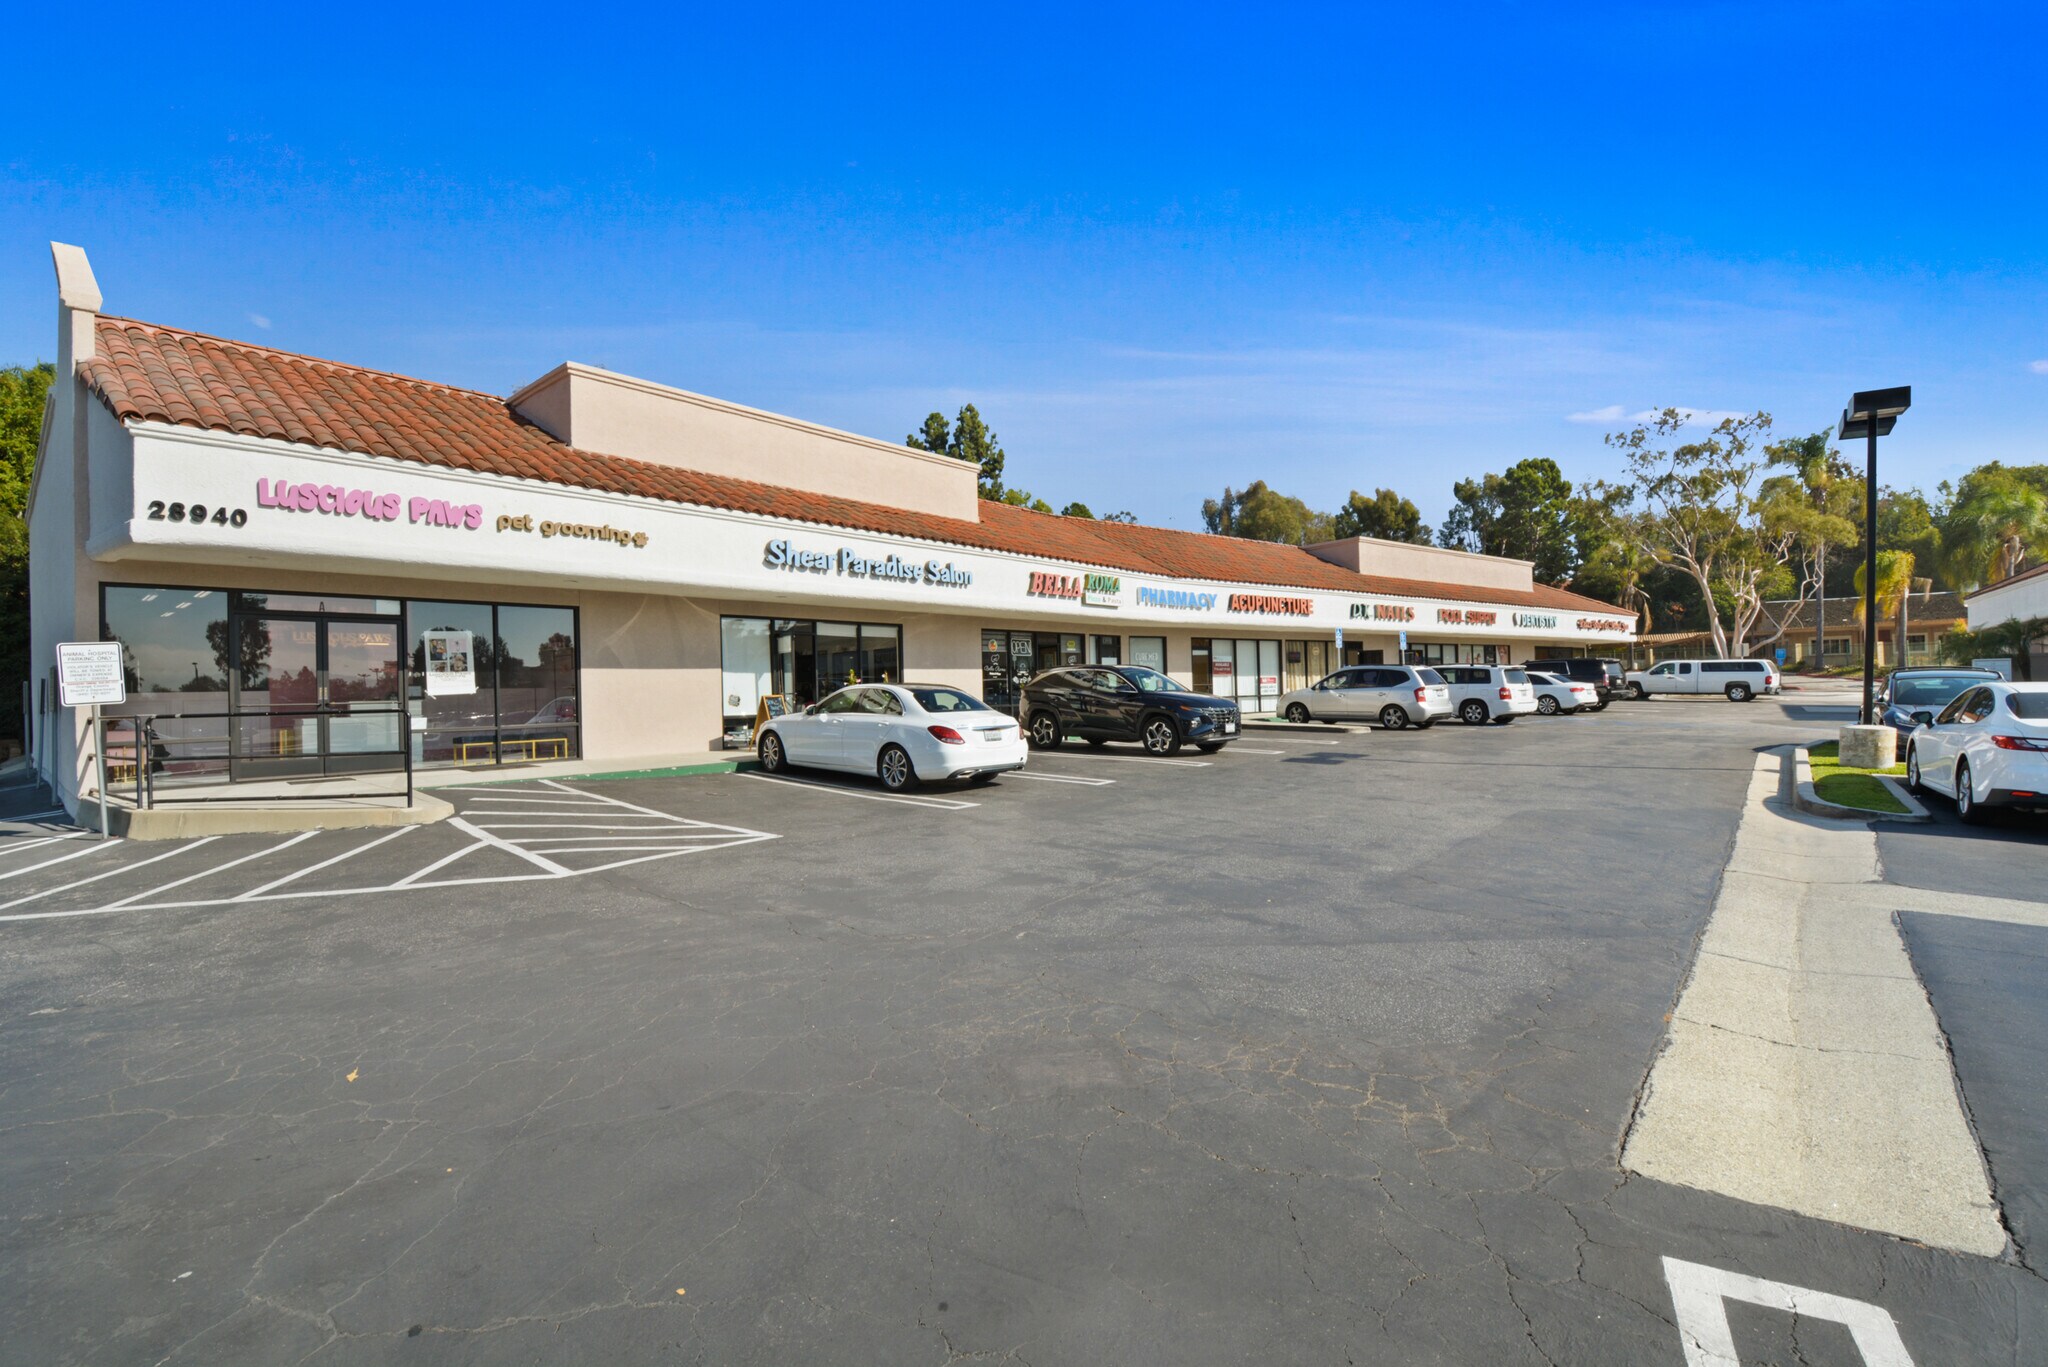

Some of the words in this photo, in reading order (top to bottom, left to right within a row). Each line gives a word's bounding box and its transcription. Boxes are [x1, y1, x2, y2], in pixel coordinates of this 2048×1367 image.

[148, 500, 248, 528] 28940
[258, 478, 401, 521] LUSCIOUS
[409, 496, 483, 530] PAWS
[497, 514, 534, 532] pet
[540, 519, 632, 547] grooming
[765, 539, 837, 572] Shear
[840, 547, 923, 581] Paradise
[925, 560, 973, 586] Salon
[1030, 572, 1083, 599] BELLA
[1085, 573, 1120, 592] ROMA
[1139, 587, 1217, 610] PHARMACY
[1229, 594, 1314, 616] ACUPUNCTURE
[1374, 604, 1415, 621] NAILS
[1437, 609, 1464, 625] POOL
[1465, 611, 1497, 626] SUPPLY
[1520, 613, 1557, 629] DENTISTRY
[1011, 641, 1031, 654] OPEN
